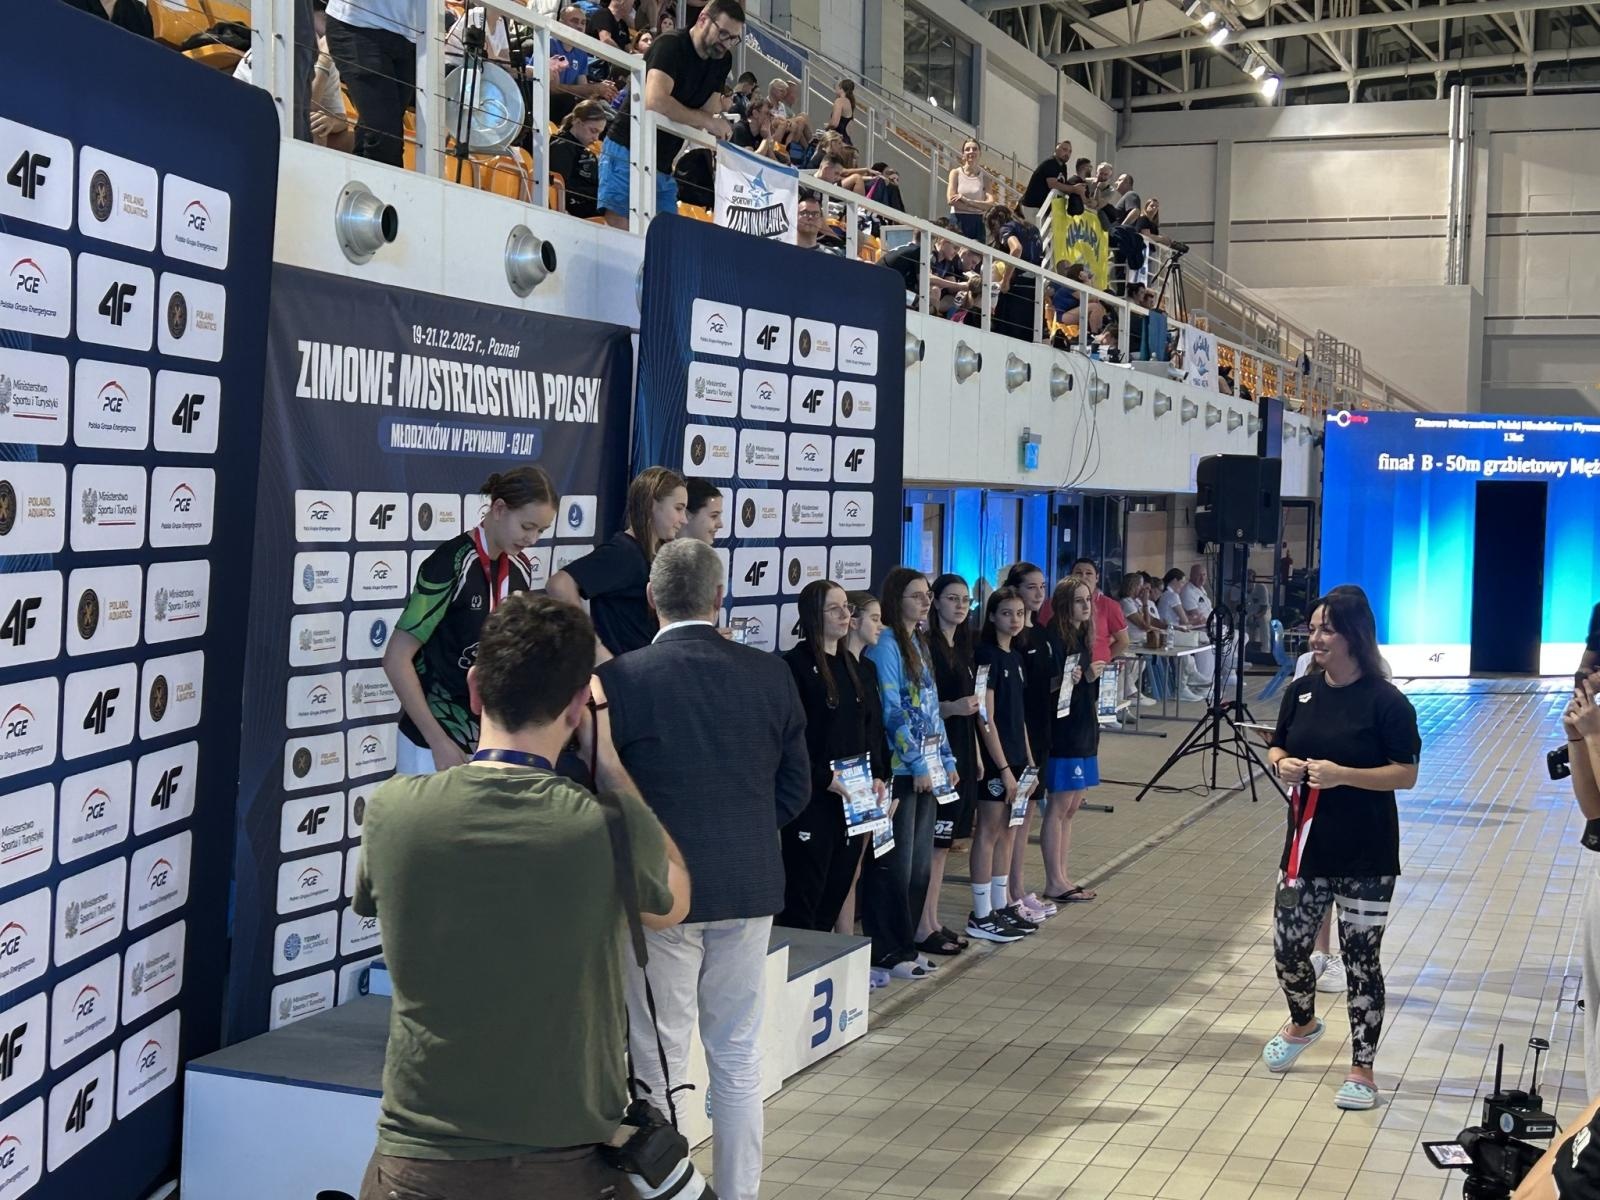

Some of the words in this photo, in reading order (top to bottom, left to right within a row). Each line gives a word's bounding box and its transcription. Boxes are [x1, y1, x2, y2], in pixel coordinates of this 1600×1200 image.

[6, 150, 51, 200] 4F
[187, 214, 207, 231] PGE
[17, 274, 41, 294] PGE
[98, 281, 137, 326] 4F
[412, 324, 476, 352] 19-21.12.2025
[487, 337, 520, 358] Poznań
[757, 324, 780, 351] 4F
[296, 339, 395, 406] ZIMOWE
[398, 353, 541, 420] MISTRZOSTWA
[102, 396, 123, 412] PGE
[171, 393, 205, 434] 4F
[802, 388, 824, 414] 4F
[390, 422, 450, 451] MŁODZIKÓW
[451, 427, 462, 451] W
[462, 428, 506, 454] PŁYWANIU
[511, 432, 520, 455] 13
[520, 433, 534, 456] LAT
[845, 448, 865, 472] 4F
[1378, 453, 1414, 471] finał
[1421, 454, 1434, 471] B
[1446, 455, 1481, 472] 50m
[1483, 456, 1569, 477] grzbietowy
[174, 498, 192, 512] PGE
[310, 510, 329, 520] PGE
[369, 504, 396, 529] 4F
[373, 570, 388, 580] PGE
[744, 560, 768, 586] 4F
[0, 597, 42, 646] 4F
[83, 687, 120, 735] 4F
[6, 719, 29, 739] PGE
[150, 765, 183, 810] 4F
[86, 801, 105, 822] PGE
[297, 805, 329, 835] 4F
[811, 978, 833, 1048] 3
[65, 1077, 99, 1133] 4F
